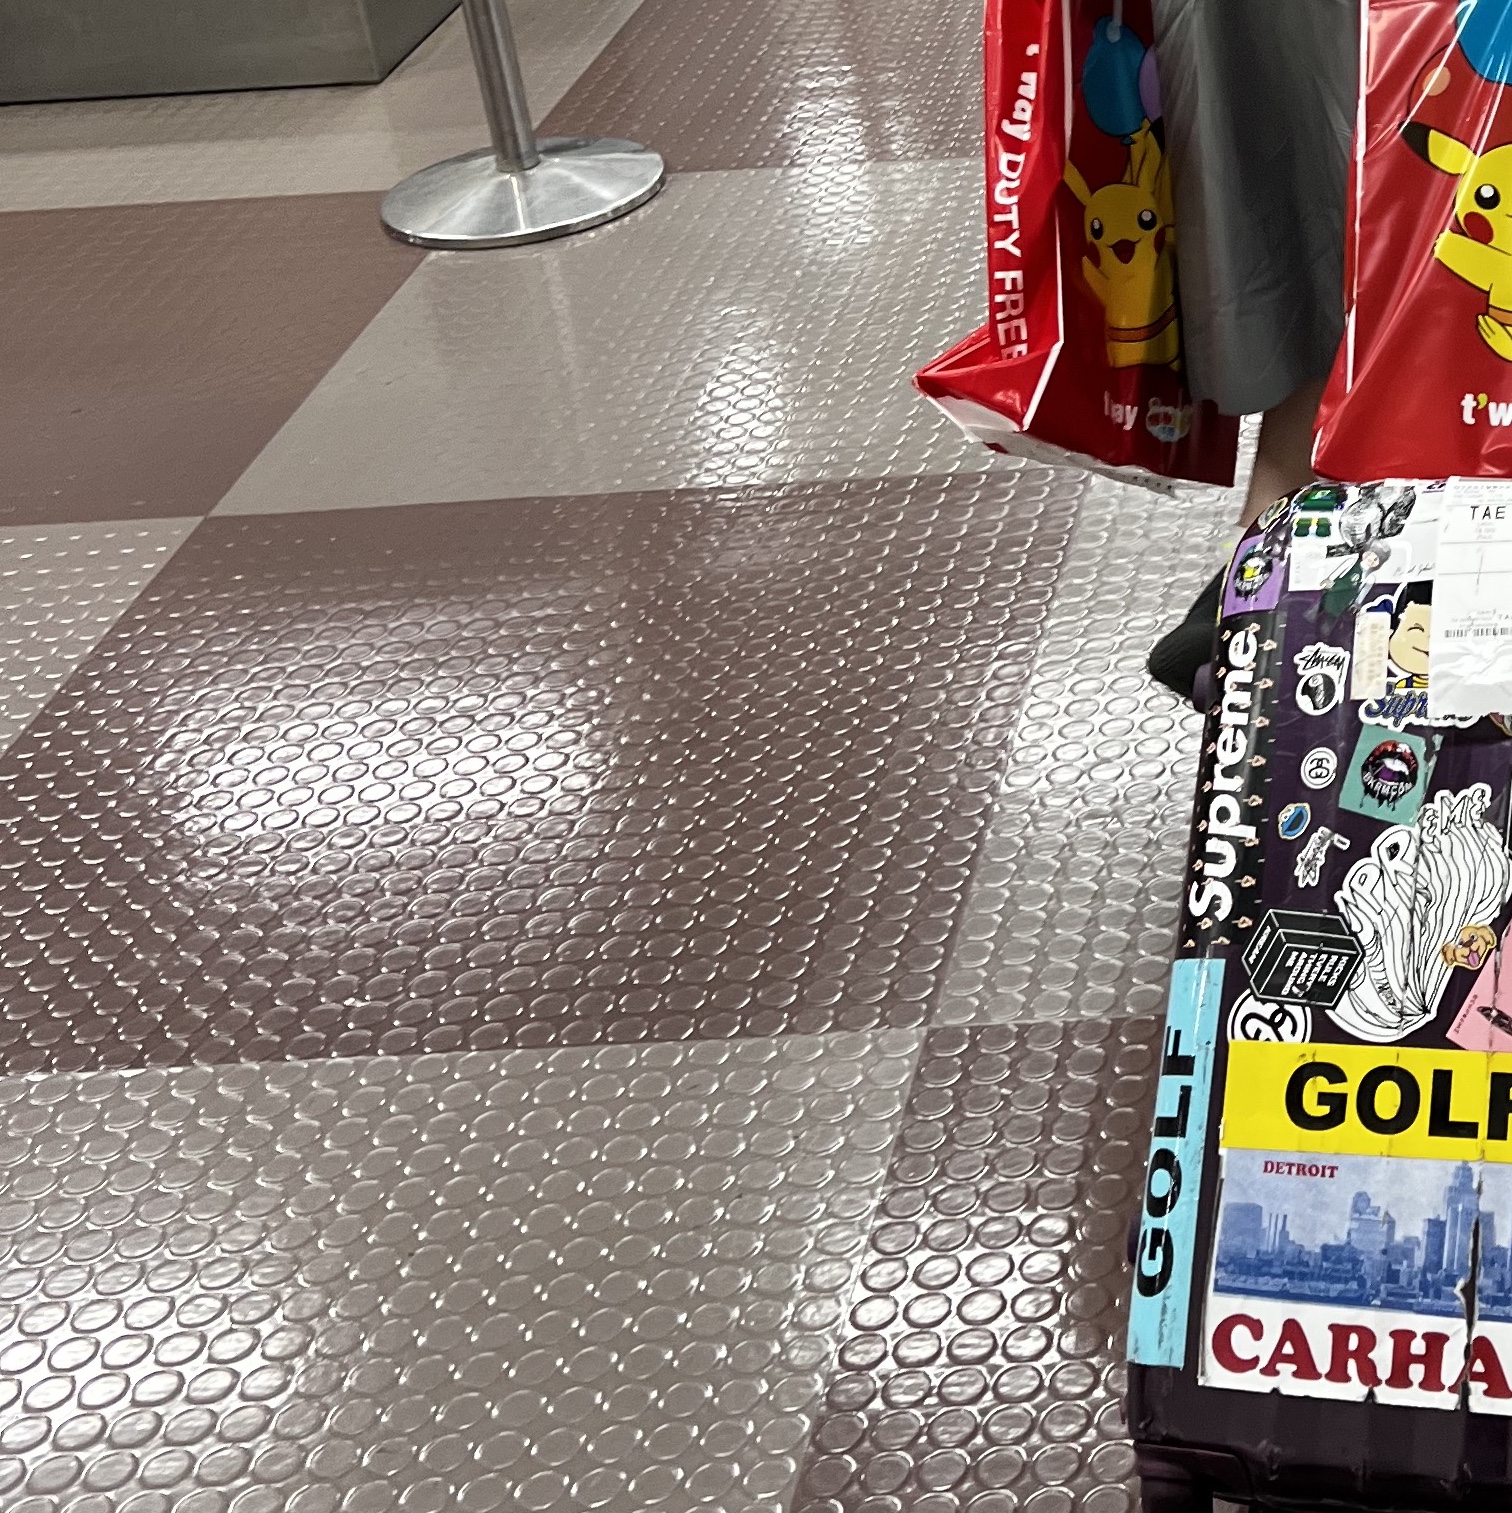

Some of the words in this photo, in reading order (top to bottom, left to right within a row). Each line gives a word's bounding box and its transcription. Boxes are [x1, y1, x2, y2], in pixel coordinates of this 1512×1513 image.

[992, 151, 1026, 258] DUTY
[1470, 505, 1507, 521] TAE
[1188, 629, 1258, 922] Supreme
[1136, 1025, 1197, 1298] GOLF
[1262, 1159, 1339, 1179] DETROIT
